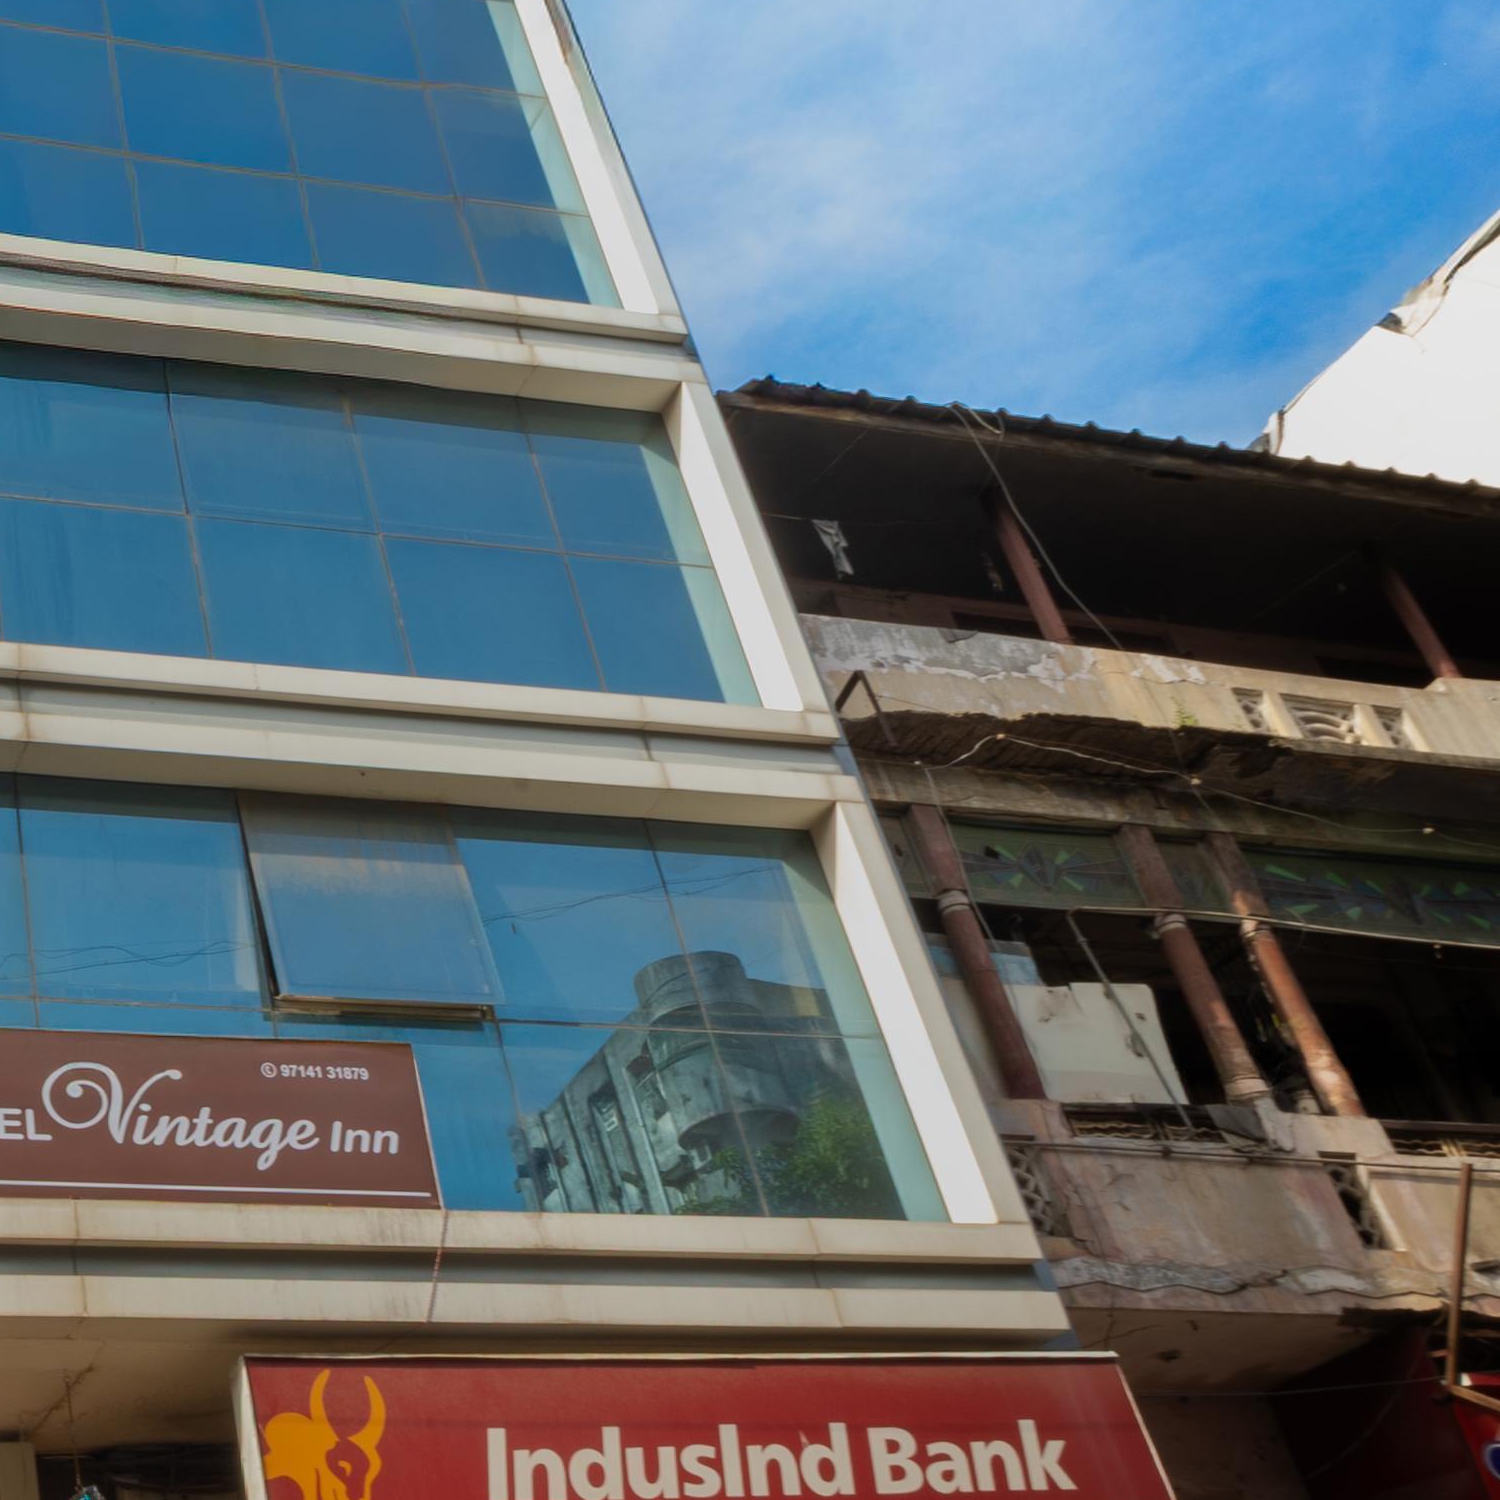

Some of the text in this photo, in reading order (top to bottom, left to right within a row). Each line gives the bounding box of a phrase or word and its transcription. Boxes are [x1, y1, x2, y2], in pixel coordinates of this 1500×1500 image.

[280, 1064, 369, 1080] 97141 31879
[42, 1061, 319, 1170] Vintage
[330, 1120, 399, 1154] Inn
[867, 1419, 1078, 1495] Bank
